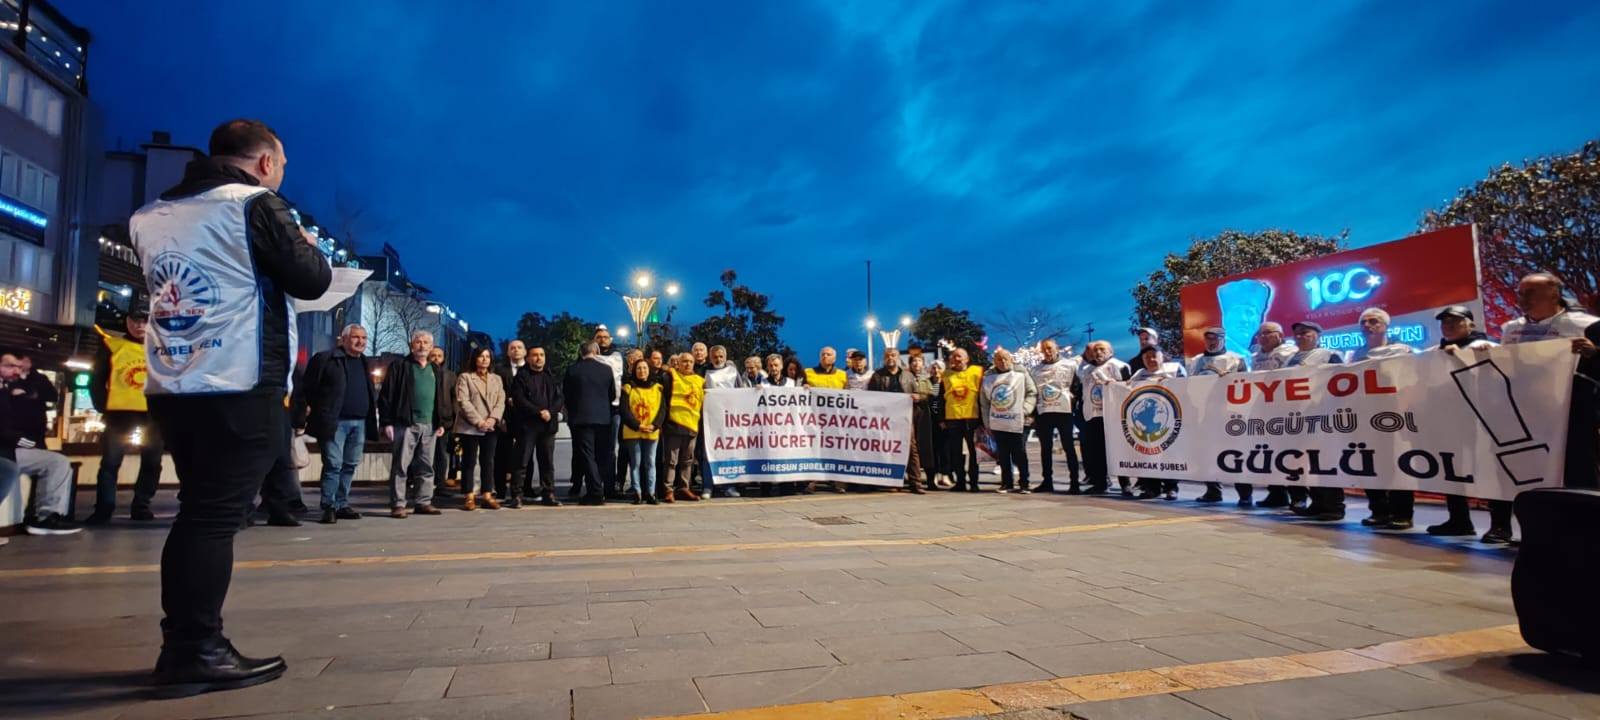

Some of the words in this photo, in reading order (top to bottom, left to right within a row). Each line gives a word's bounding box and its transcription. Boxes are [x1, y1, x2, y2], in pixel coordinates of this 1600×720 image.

[1226, 378, 1311, 405] ÜYE
[1327, 369, 1396, 397] OL
[757, 392, 812, 407] ASGARİ
[816, 394, 859, 410] DEĞİL
[724, 410, 795, 428] İNSANCA
[799, 413, 891, 431] YAŞAYACAK
[1225, 407, 1358, 436] ÖRGÜTLÜ
[713, 431, 764, 451] AZAMİ
[768, 431, 816, 449] ÜCRET
[820, 433, 902, 454] İSTİYORUZ
[718, 465, 746, 475] KESK
[761, 463, 797, 472] GİRESUN
[798, 462, 836, 471] ŞUBELER
[837, 464, 892, 476] PLATFORMU
[1119, 461, 1158, 470] BULANCAK
[1160, 461, 1188, 471] ŞUBESİ
[1216, 442, 1377, 481] GÜÇLÜ
[1397, 450, 1475, 484] OL
